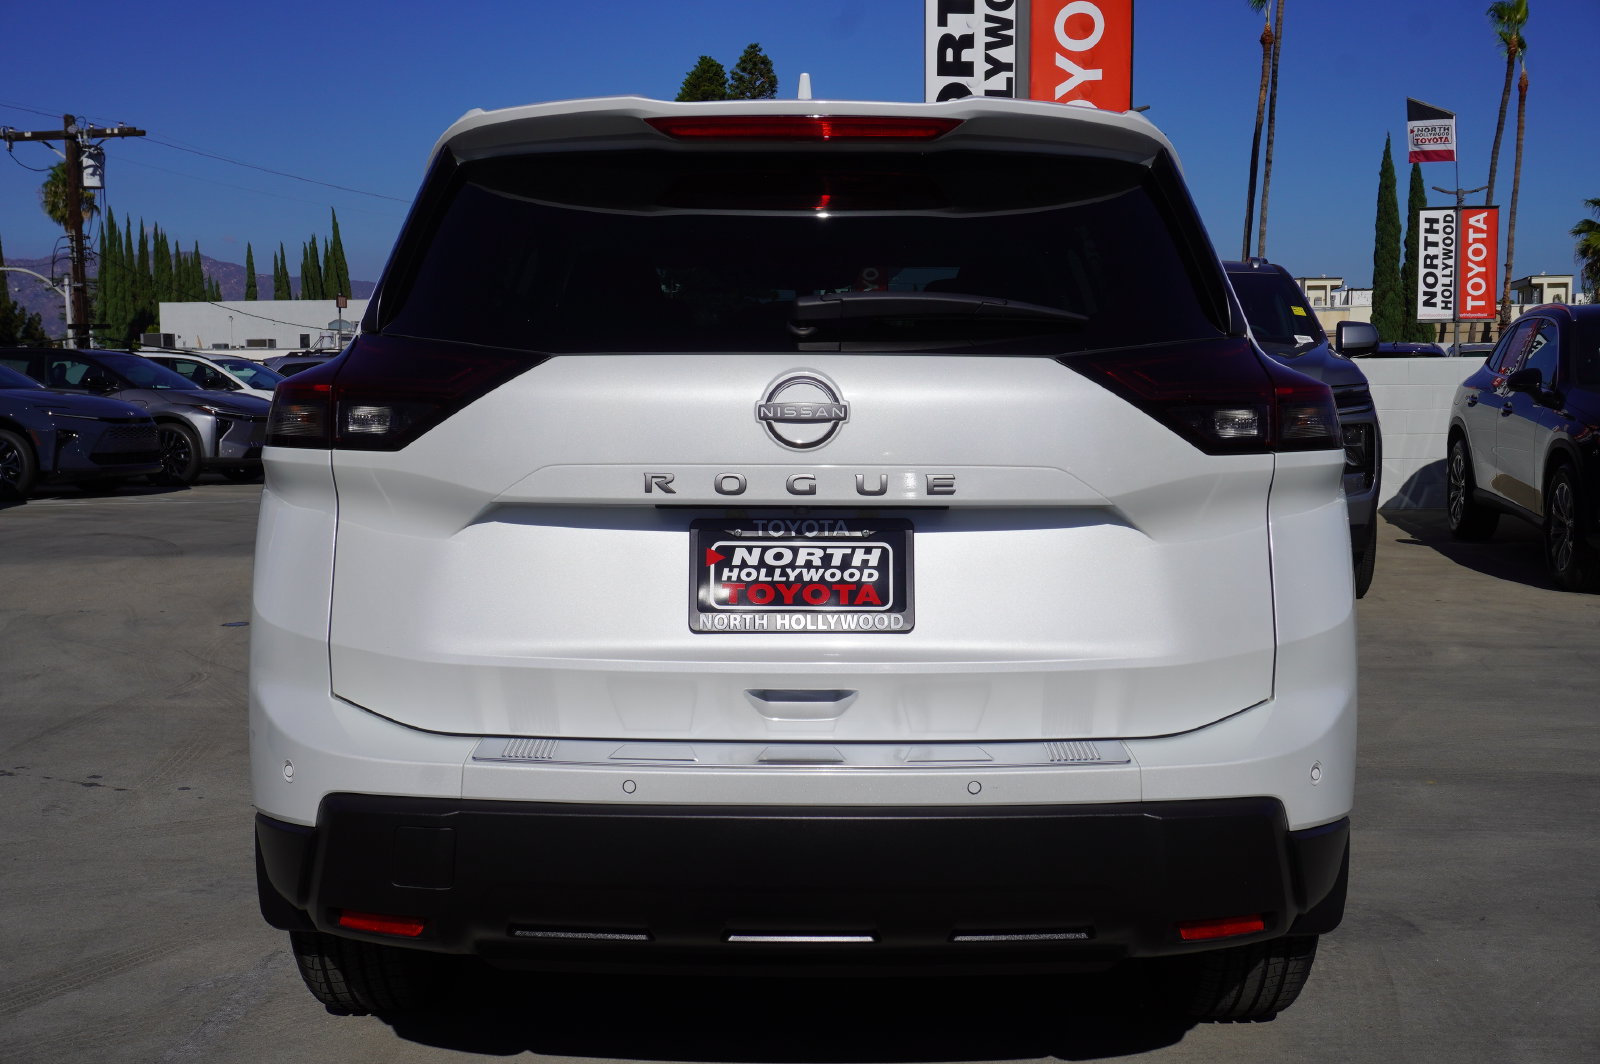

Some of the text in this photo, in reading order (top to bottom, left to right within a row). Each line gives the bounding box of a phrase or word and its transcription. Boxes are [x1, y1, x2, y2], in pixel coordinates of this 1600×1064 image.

[1054, 0, 1105, 108] YO
[1422, 217, 1440, 308] NORTH
[1441, 213, 1455, 311] HOLLYWOOD
[1466, 211, 1488, 311] TOYOTA
[760, 405, 846, 418] NISSAN
[644, 472, 956, 496] ROGUE
[753, 519, 849, 537] TOYOTA
[731, 547, 882, 566] NORTH
[721, 568, 879, 582] HOLLYWOOD
[722, 583, 882, 605] TOYOTA
[699, 613, 904, 631] NORTH HOLLYWOOD
